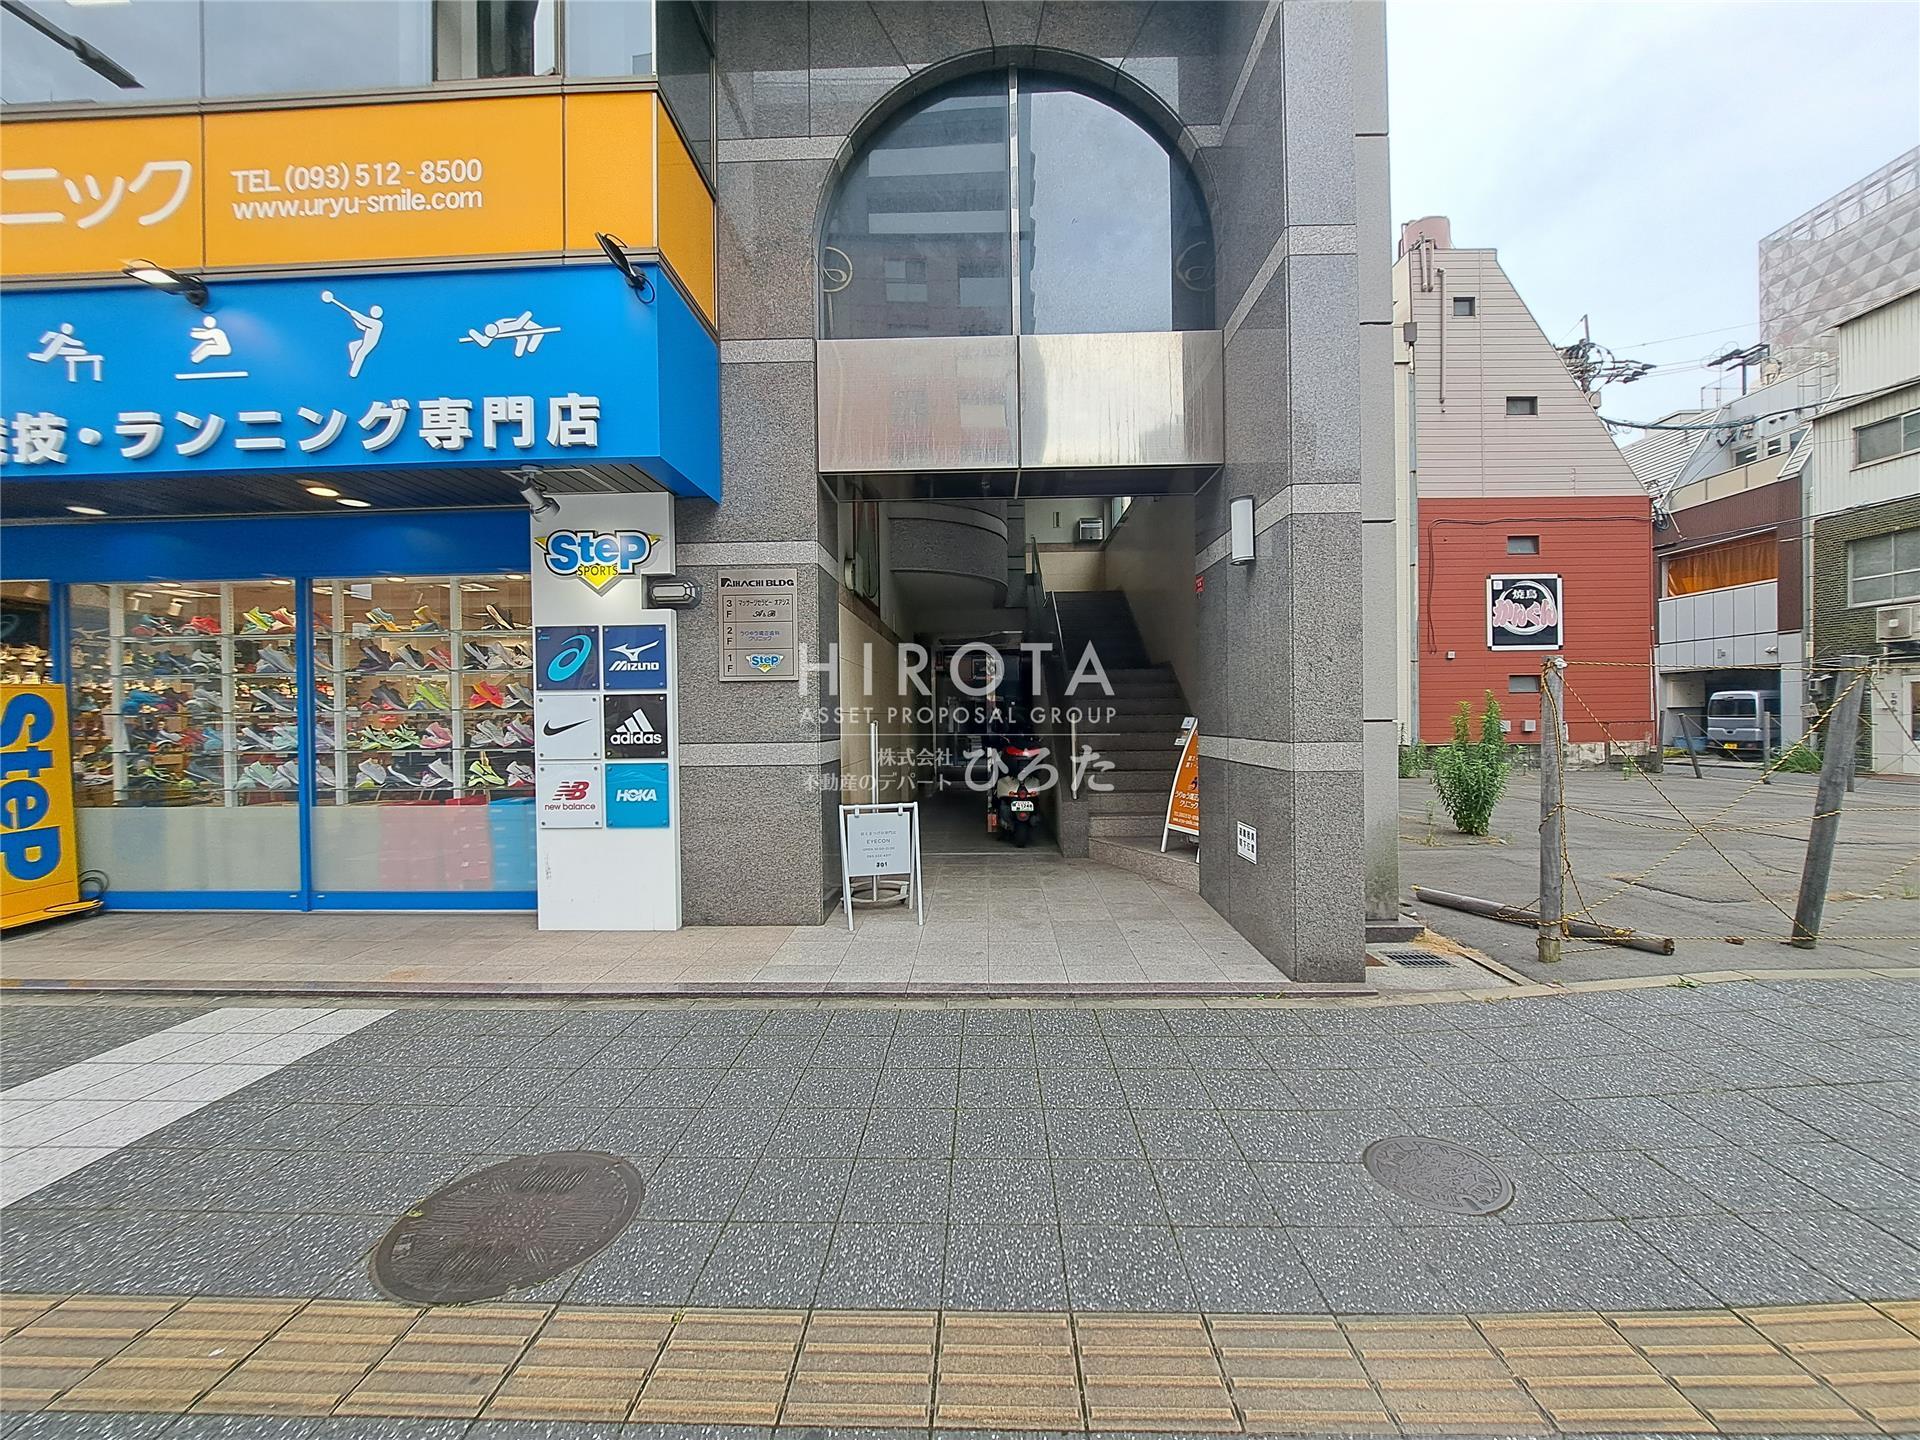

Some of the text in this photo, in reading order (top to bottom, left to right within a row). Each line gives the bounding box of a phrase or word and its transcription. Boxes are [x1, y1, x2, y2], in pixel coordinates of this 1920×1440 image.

[231, 171, 281, 195] TEL
[232, 188, 483, 221] www.uryu-smile.com
[0, 392, 602, 466] 技・ランニング専門店
[576, 565, 618, 576] SPORTS
[610, 731, 662, 745] adidas
[616, 789, 657, 802] HOKA
[544, 802, 596, 811] new balance
